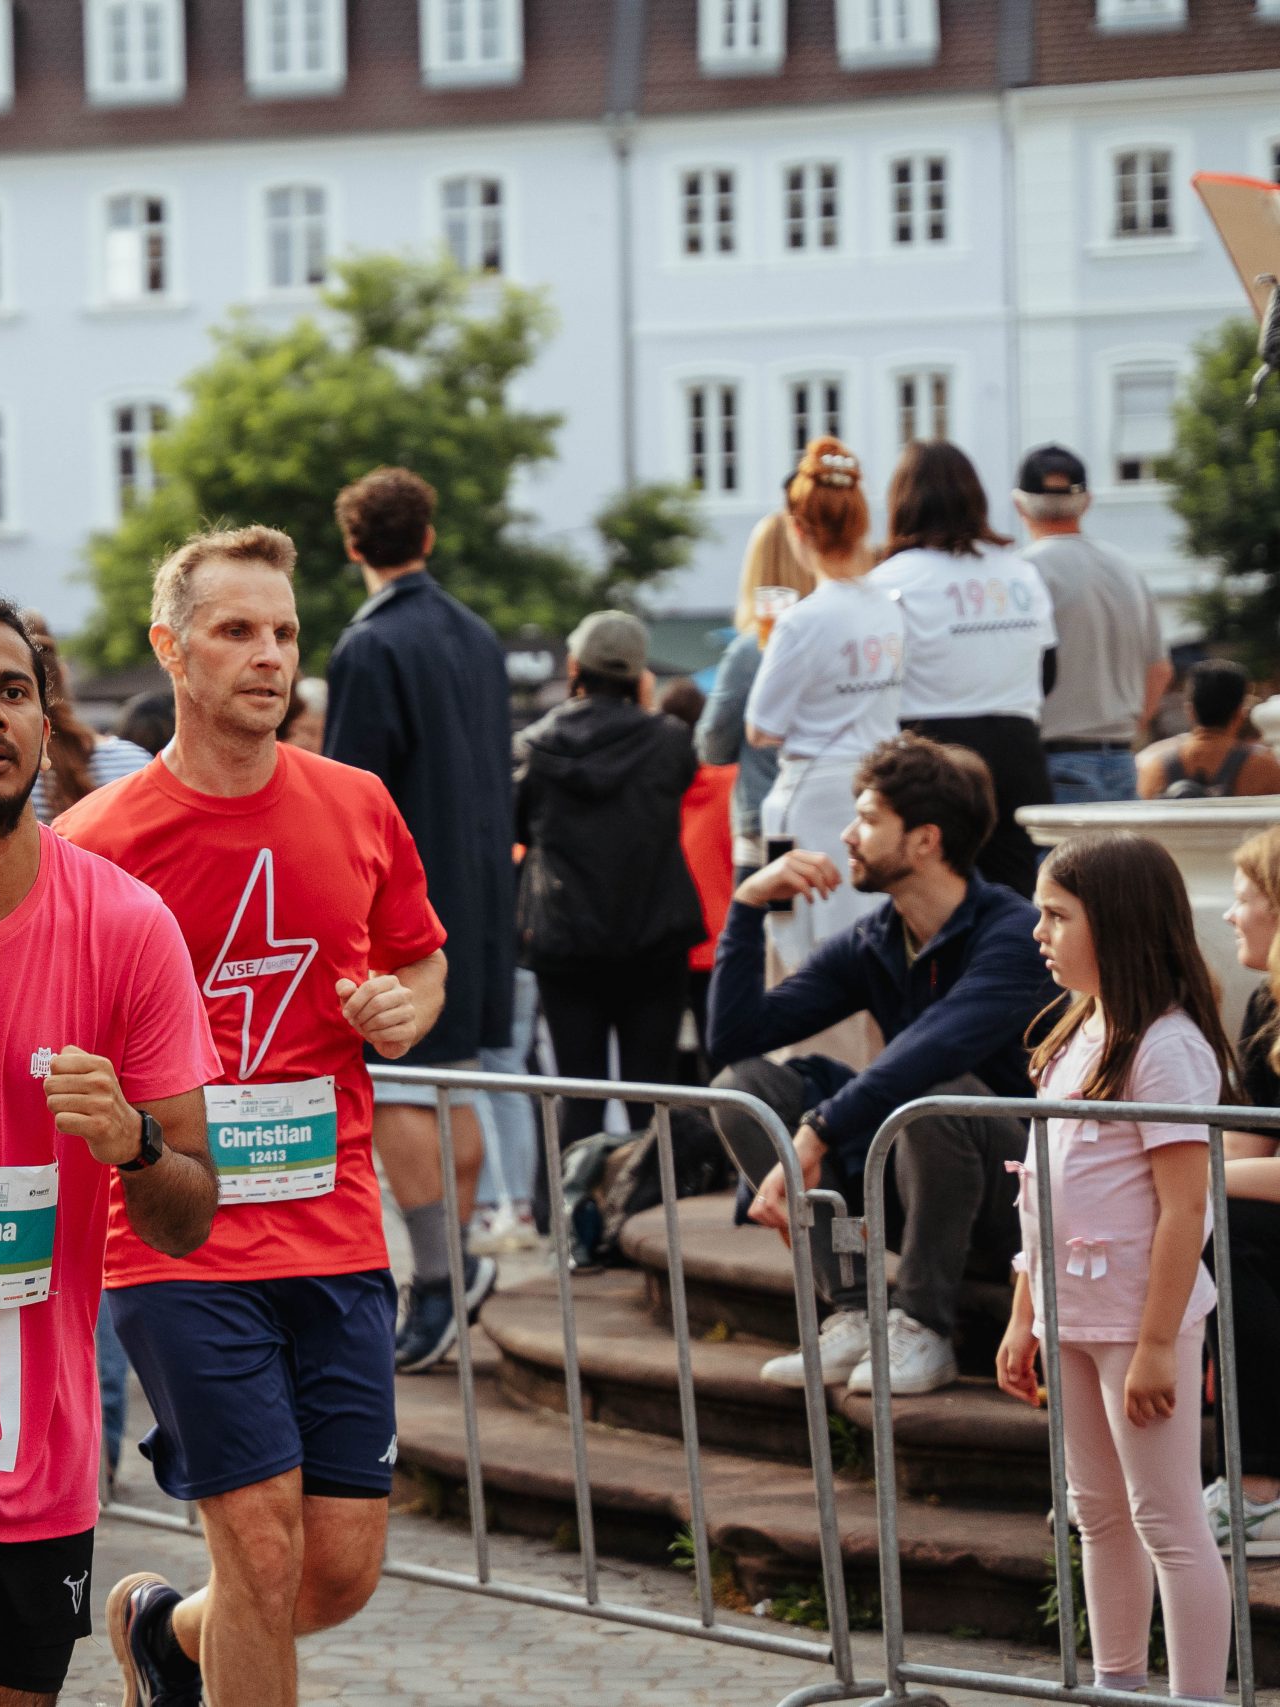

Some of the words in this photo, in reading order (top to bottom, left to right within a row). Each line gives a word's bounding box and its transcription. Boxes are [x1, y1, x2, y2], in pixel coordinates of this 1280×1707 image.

[945, 577, 1032, 617] 1990
[840, 632, 903, 677] 199
[226, 963, 254, 977] VSE
[218, 1124, 312, 1148] Christian
[249, 1150, 287, 1164] 12413
